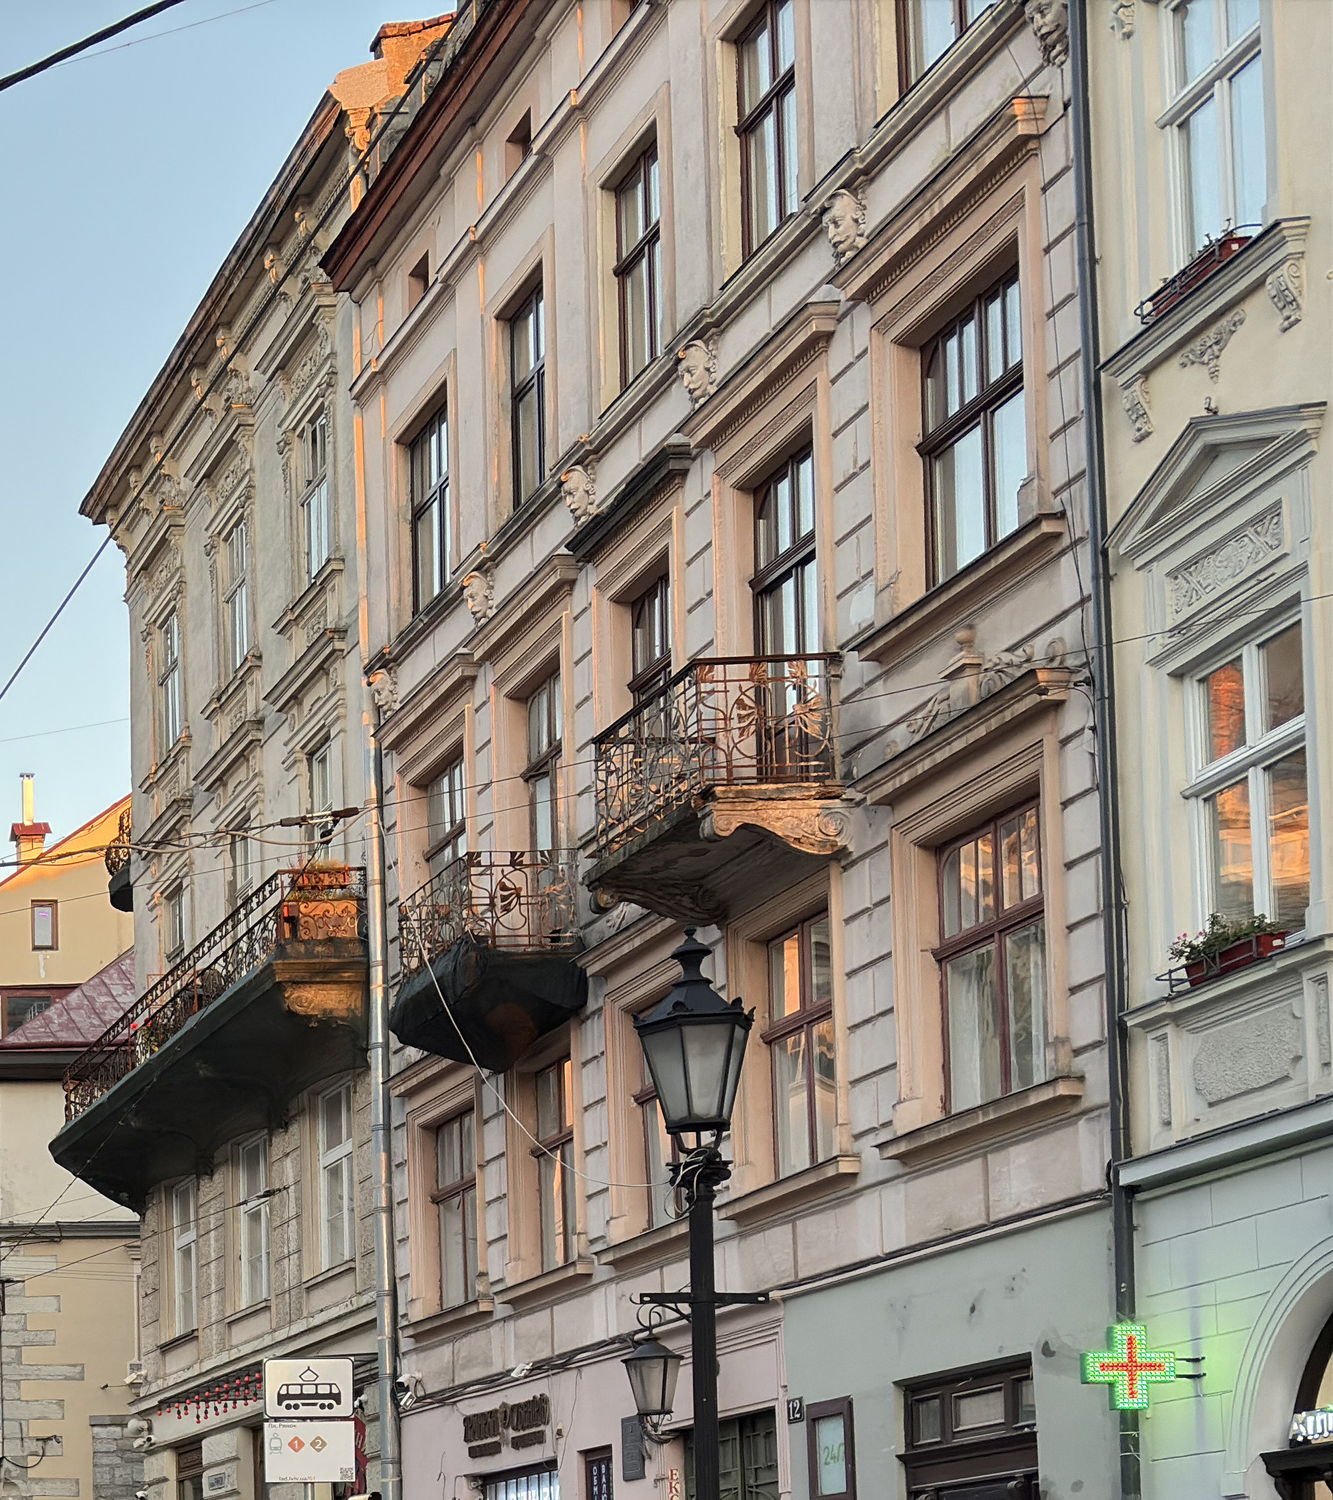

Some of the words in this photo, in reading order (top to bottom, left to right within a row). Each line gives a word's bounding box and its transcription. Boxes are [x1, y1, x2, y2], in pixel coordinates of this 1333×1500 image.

[788, 1399, 801, 1420] 12
[293, 1440, 299, 1449] 1
[314, 1439, 322, 1449] 2
